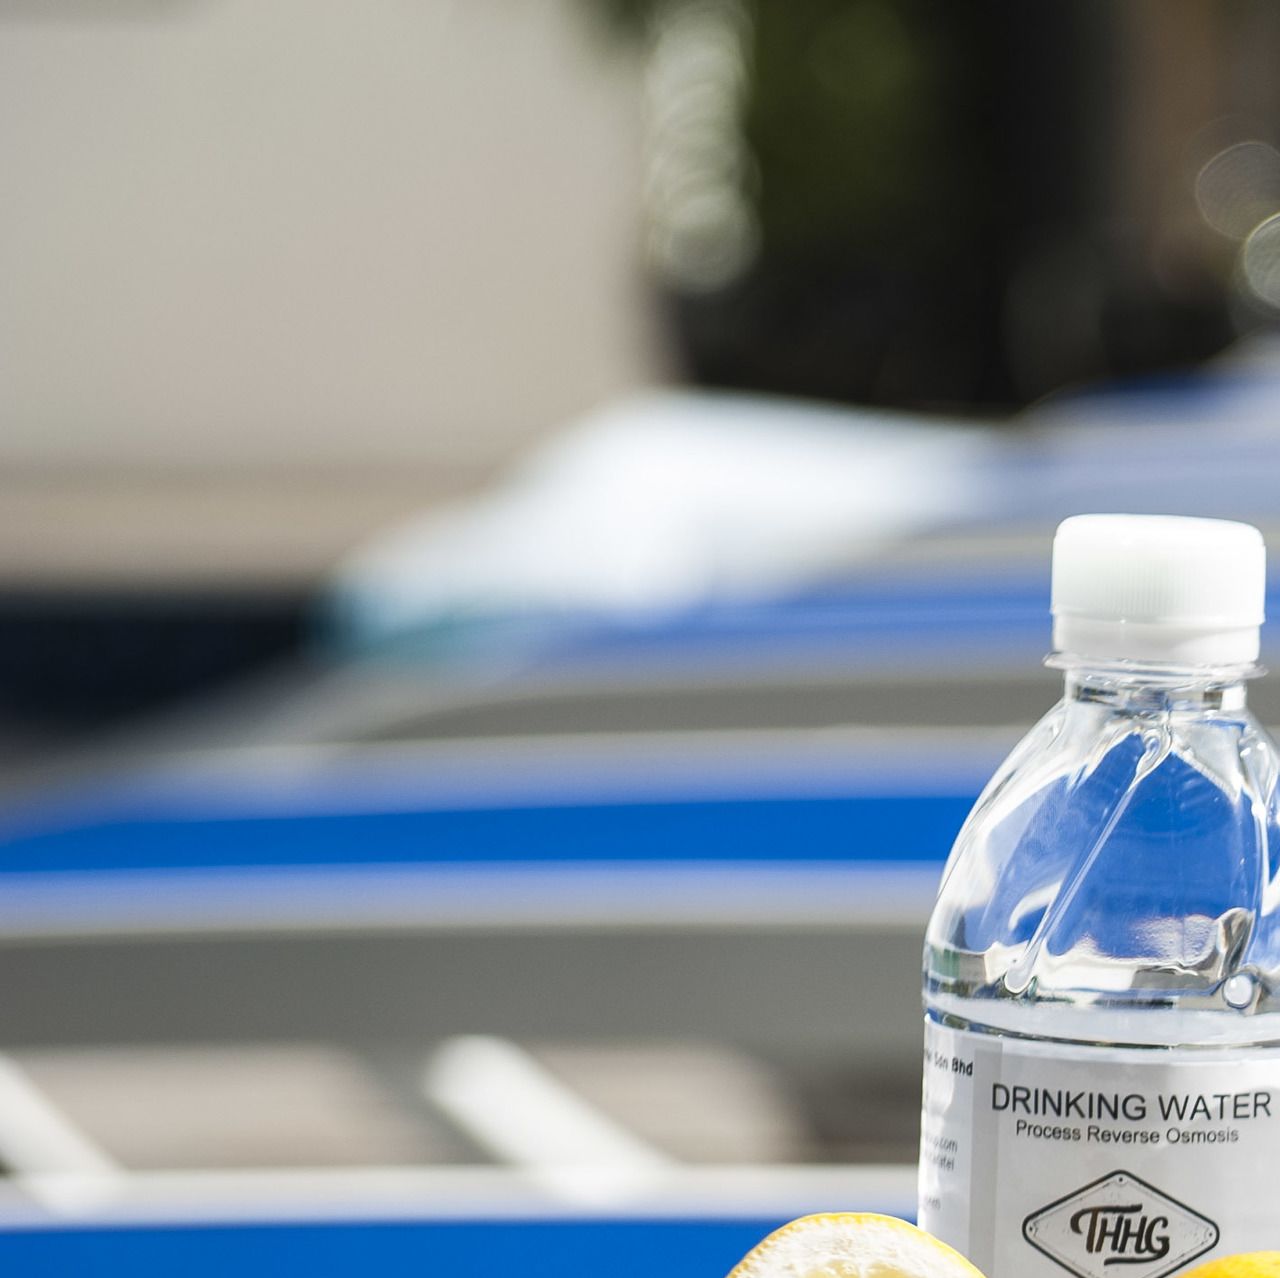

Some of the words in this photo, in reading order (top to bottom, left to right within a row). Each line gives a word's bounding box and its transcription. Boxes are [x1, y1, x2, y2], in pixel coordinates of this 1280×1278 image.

[952, 1057, 974, 1077] Bhd
[991, 1083, 1147, 1121] DRINKING
[1158, 1091, 1272, 1121] WATER
[1016, 1120, 1081, 1142] Process
[1087, 1125, 1160, 1144] Reverse
[1166, 1126, 1239, 1144] Osmosis
[1070, 1203, 1171, 1266] THHG
